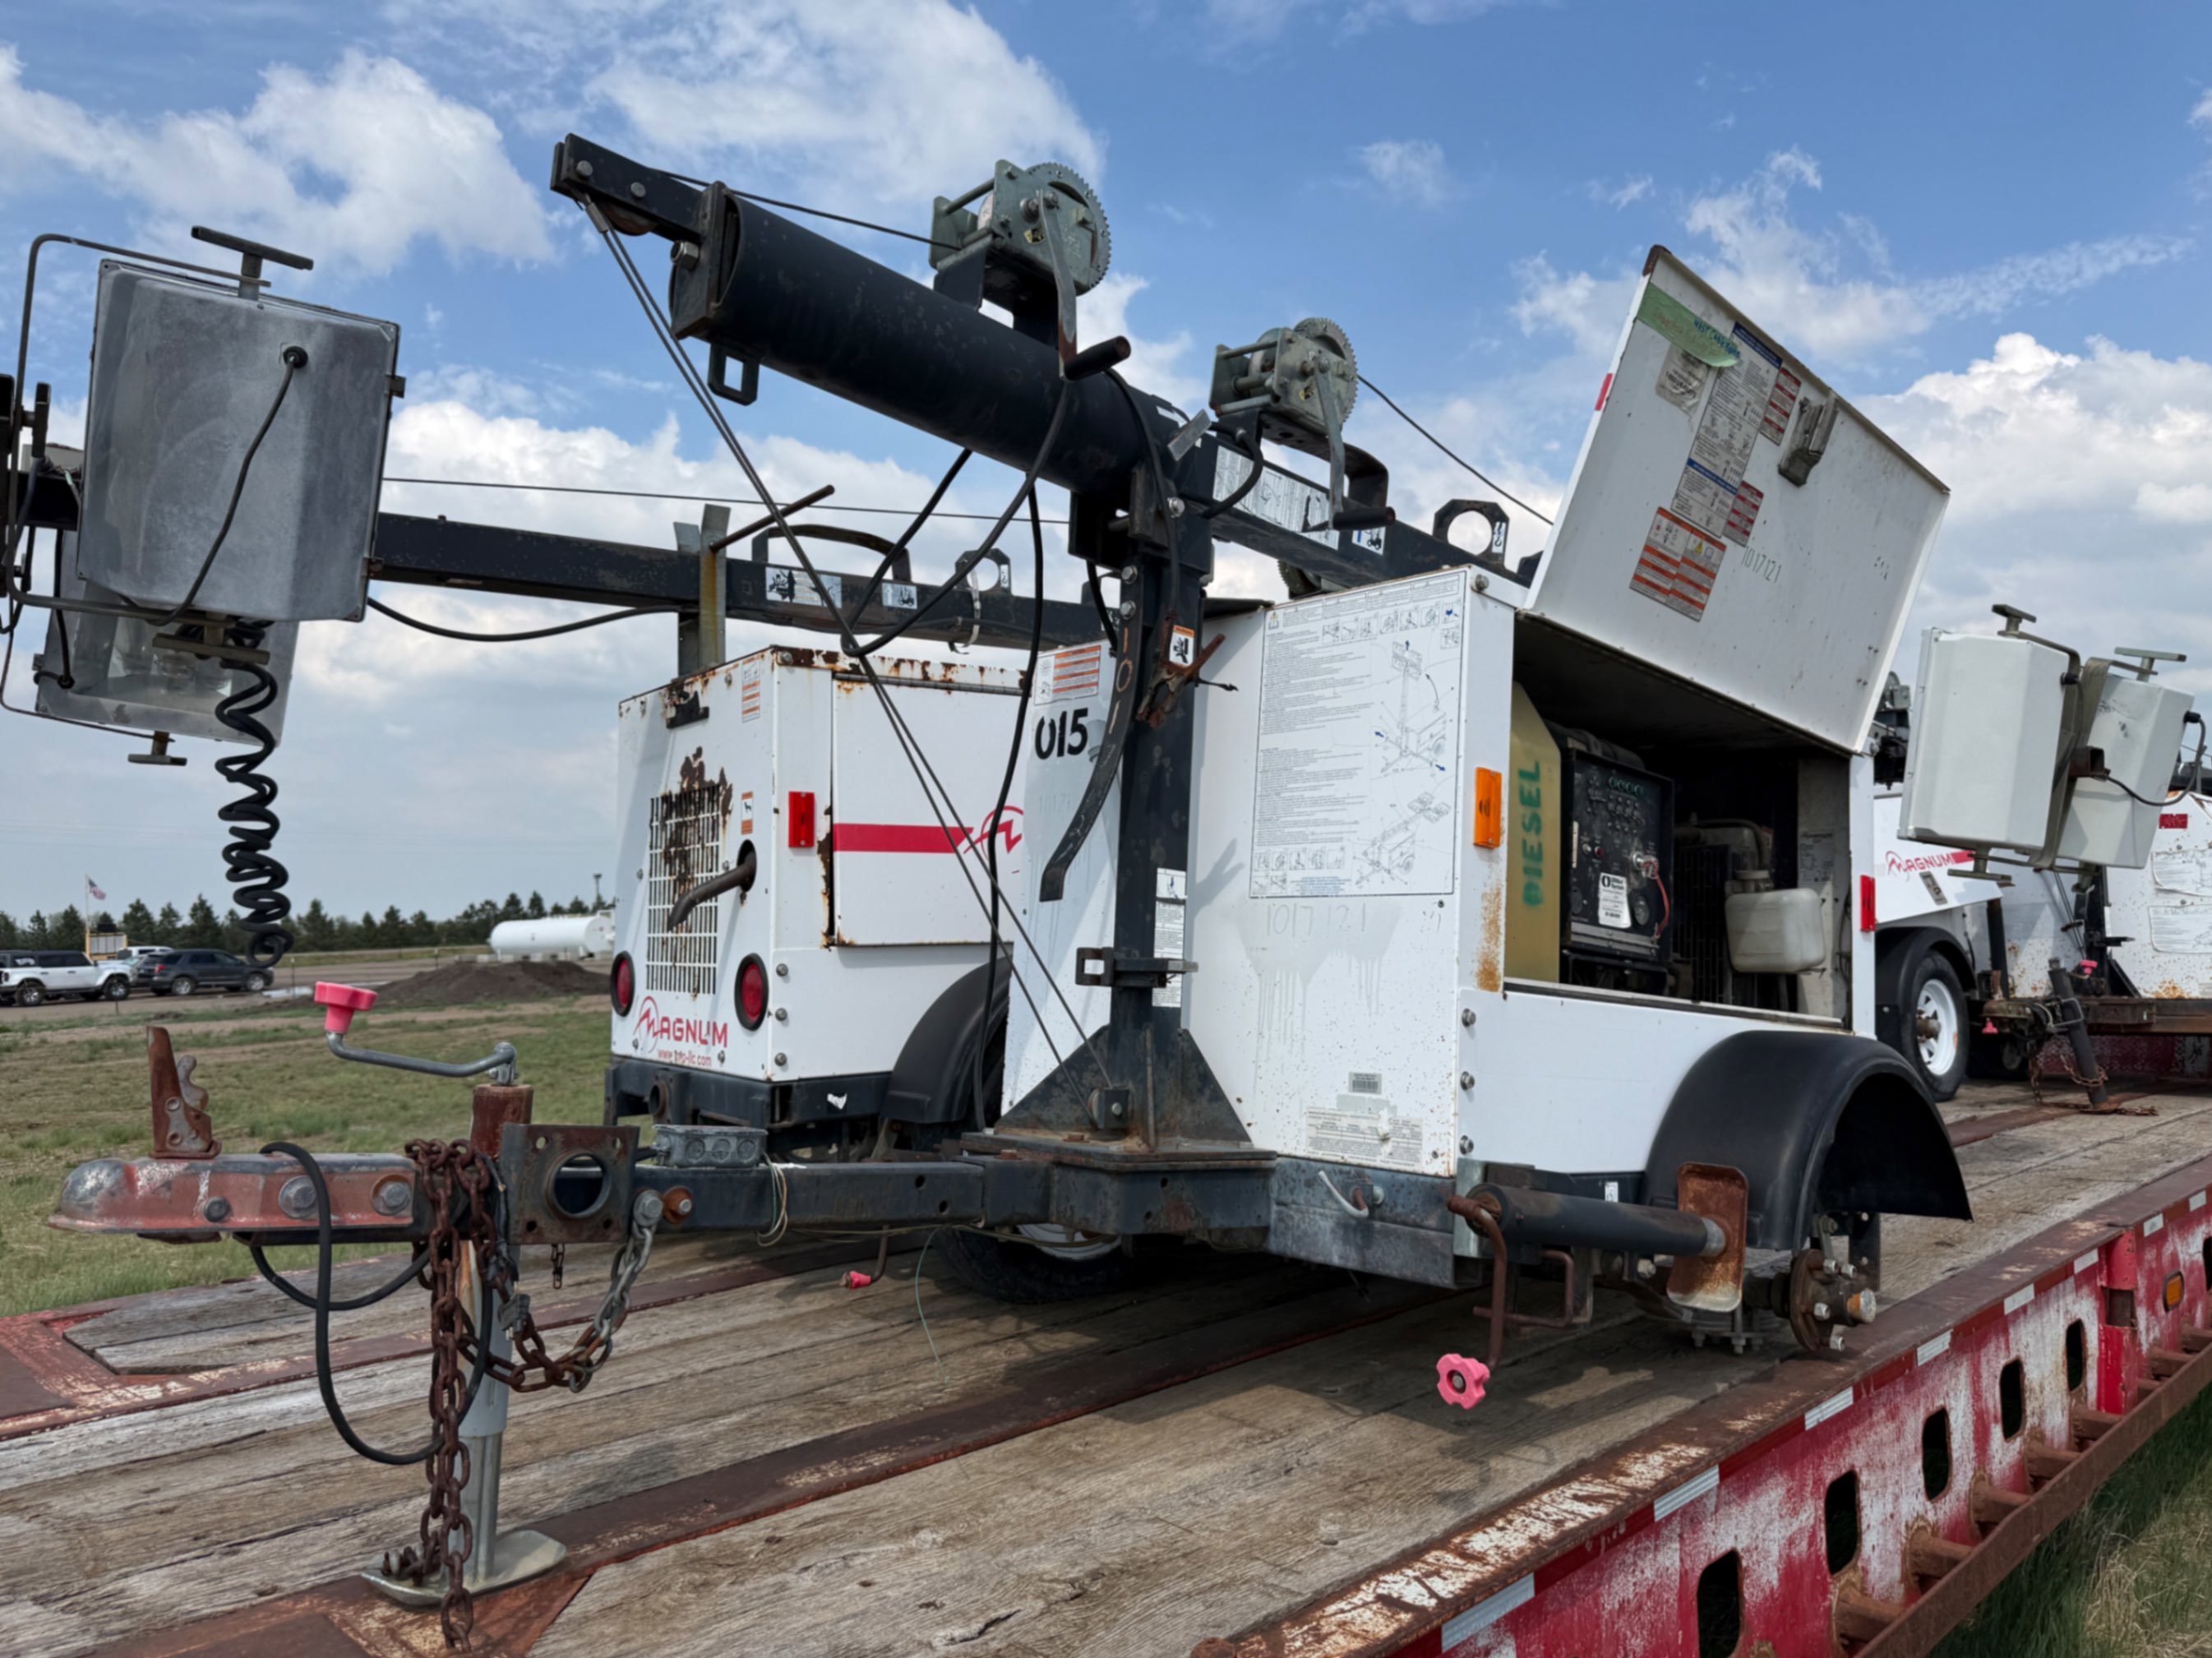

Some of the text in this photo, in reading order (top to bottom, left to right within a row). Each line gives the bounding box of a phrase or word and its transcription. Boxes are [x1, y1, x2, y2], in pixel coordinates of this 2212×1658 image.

[1034, 707, 1088, 760] 015
[1517, 760, 1545, 908] DIESEL
[1886, 850, 1955, 876] MAGNUM
[633, 997, 728, 1049] MAGNUM
